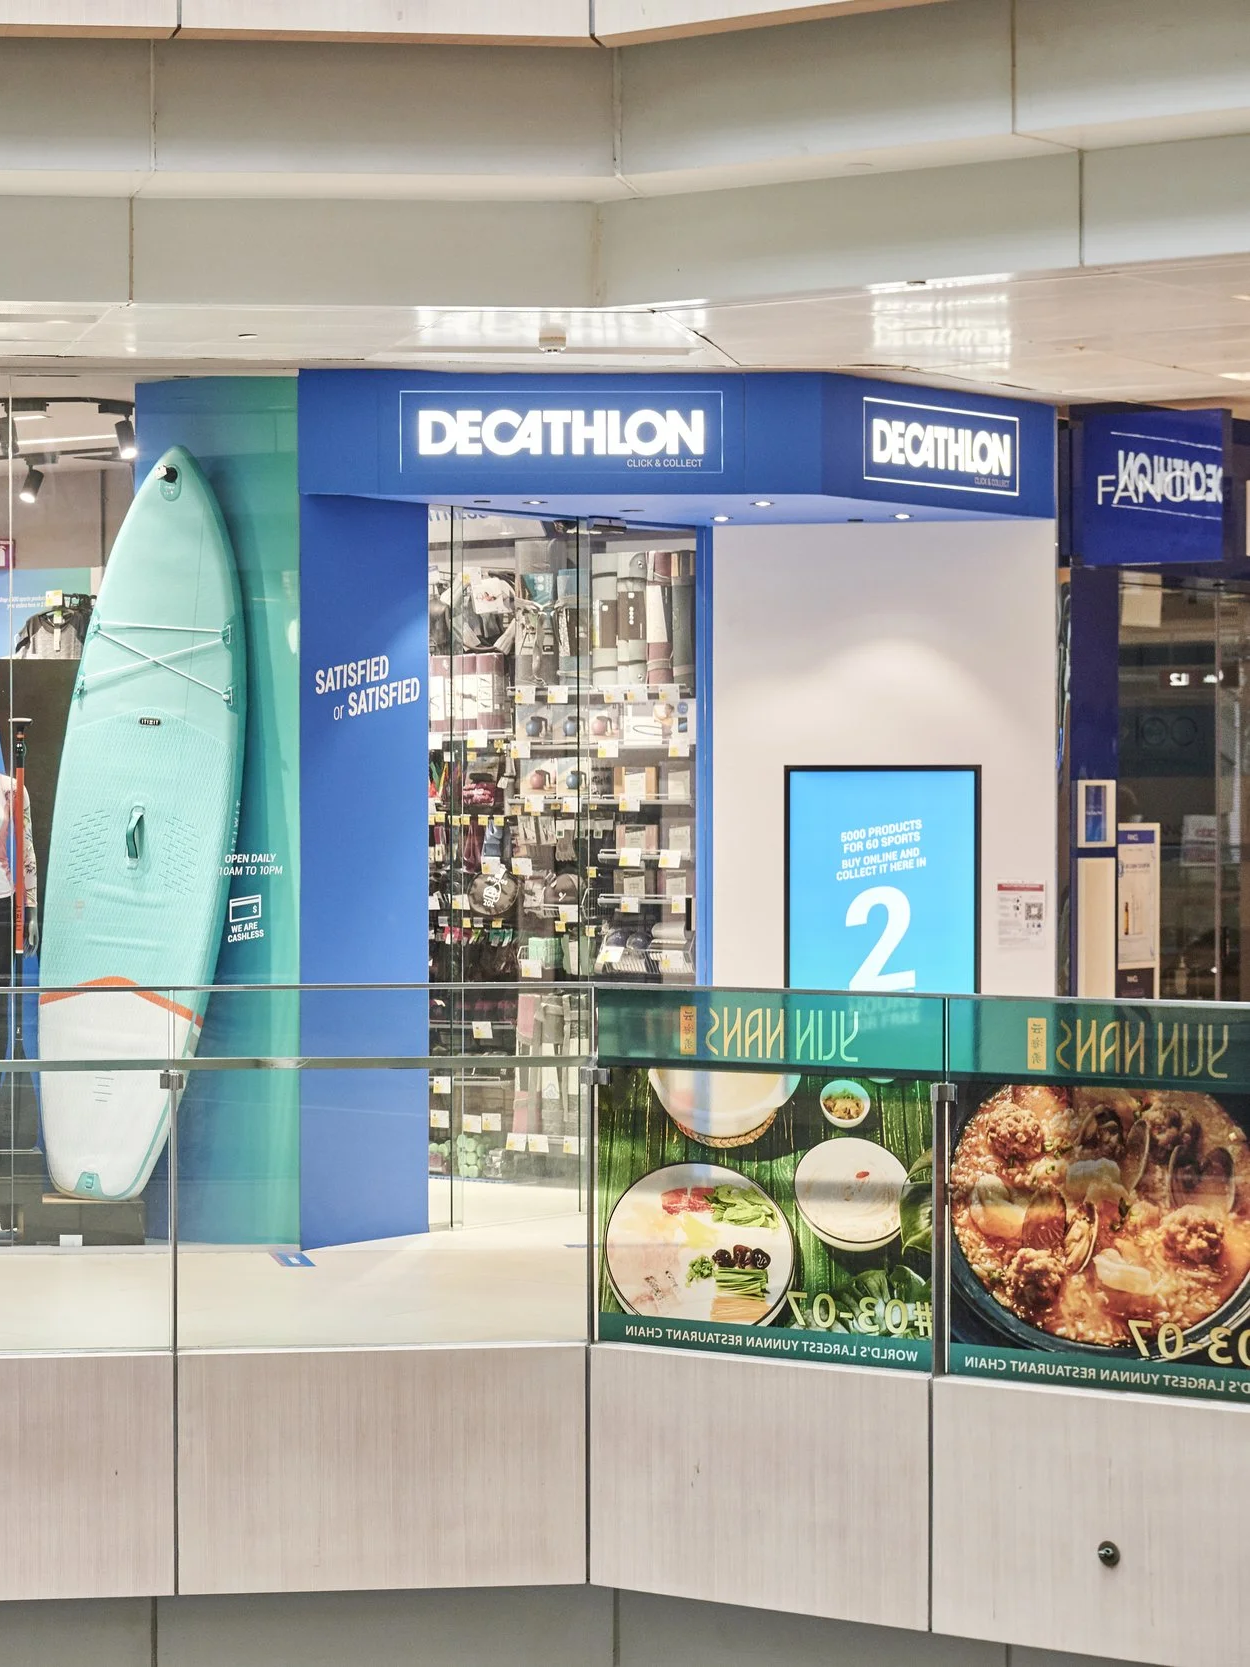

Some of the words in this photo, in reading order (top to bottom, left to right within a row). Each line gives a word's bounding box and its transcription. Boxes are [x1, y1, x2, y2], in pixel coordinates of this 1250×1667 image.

[417, 408, 706, 456] DECATHLON
[872, 418, 1011, 477] DECATHLON
[626, 458, 653, 468] CLICK
[654, 459, 662, 467] &
[663, 458, 703, 468] COLLECT
[315, 655, 389, 695] SATISFIED
[333, 704, 345, 721] or
[348, 677, 421, 717] SATISFIED
[840, 828, 867, 843] 5000
[868, 819, 922, 838] PRODUCTS
[843, 839, 864, 854] FOR
[866, 838, 879, 850] 60
[881, 831, 921, 848] SPORTS
[224, 853, 250, 863] OPEN
[251, 853, 277, 863] DAILY
[836, 865, 877, 881] COLLECT
[879, 864, 887, 874] IT
[890, 860, 914, 873] HERE
[916, 857, 927, 868] IN
[841, 857, 861, 869] BUY
[863, 851, 898, 866] ONLINE
[899, 847, 920, 860] AND
[218, 866, 243, 876] 10AM
[245, 866, 257, 876] TO
[260, 865, 283, 875] 10PM
[227, 929, 264, 943] CASHLESS
[231, 924, 243, 933] WE
[243, 922, 258, 931] ARE
[845, 885, 916, 992] 2
